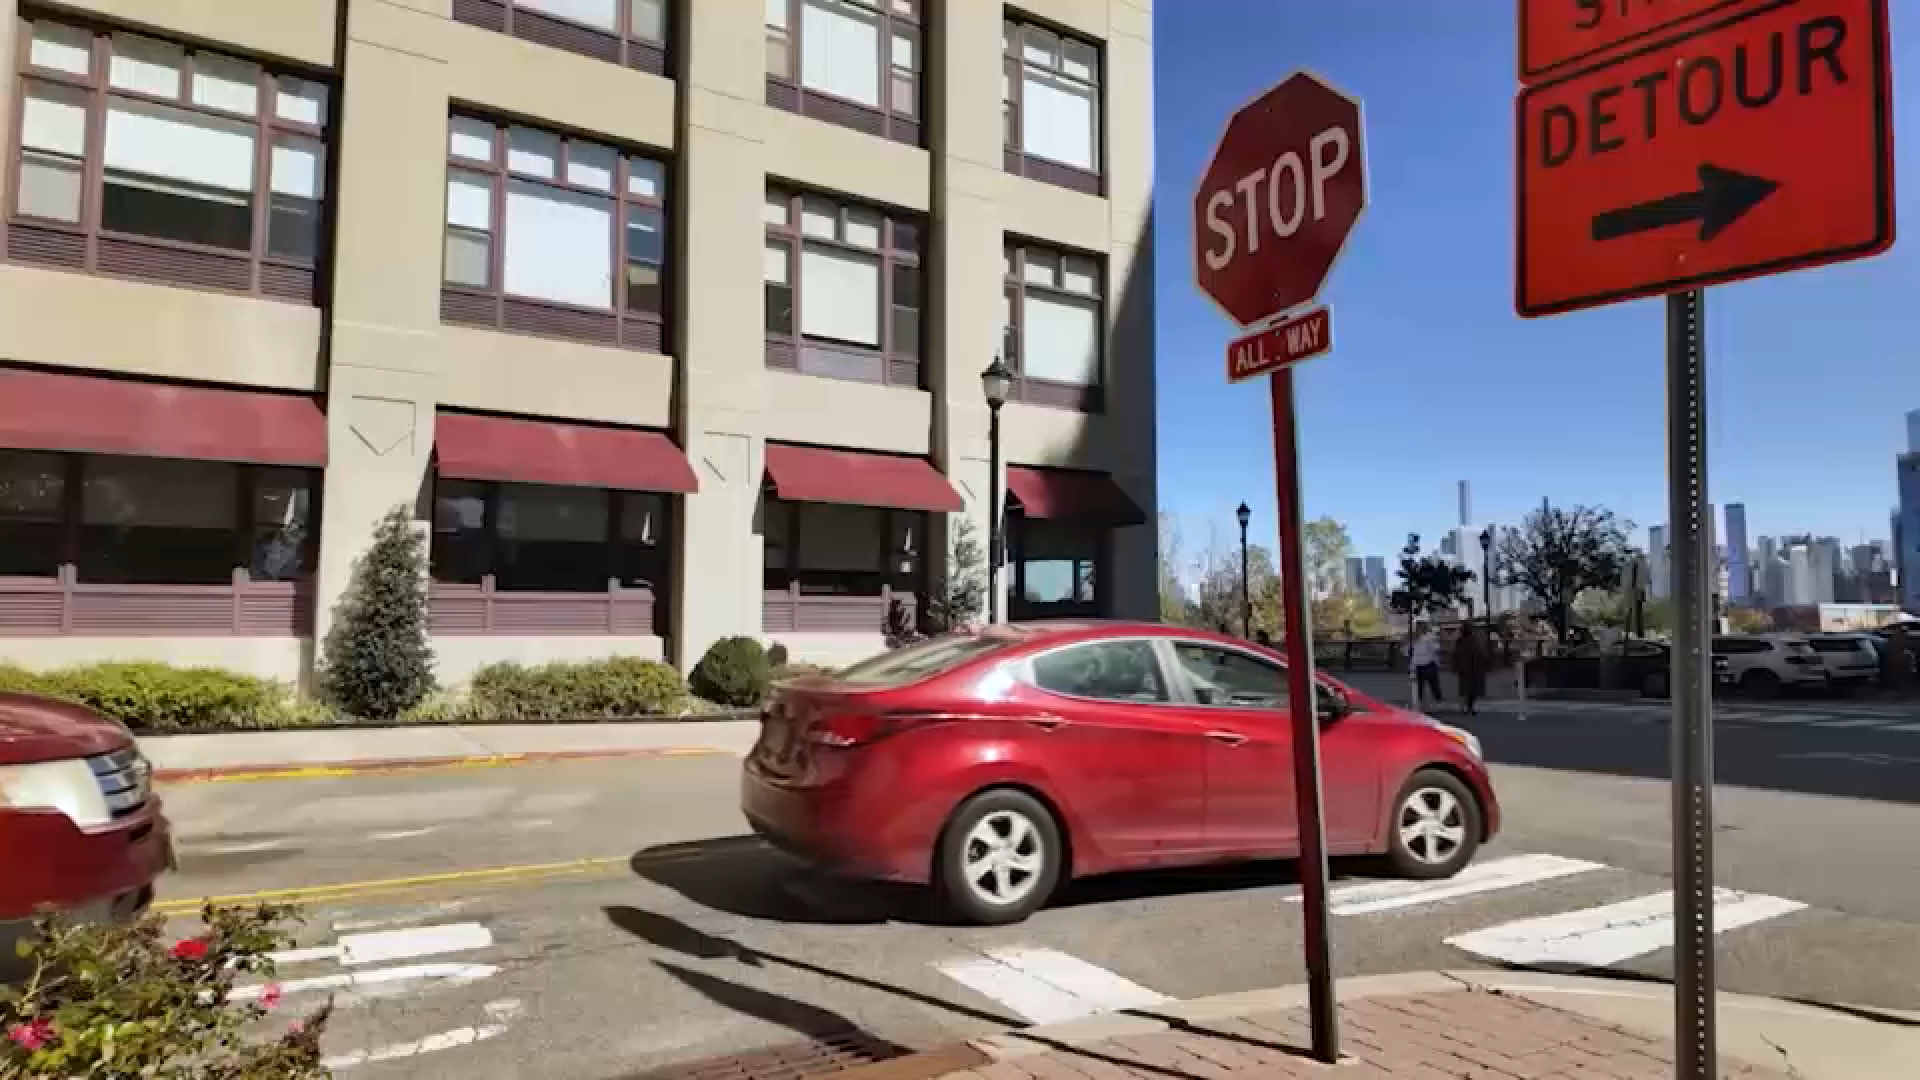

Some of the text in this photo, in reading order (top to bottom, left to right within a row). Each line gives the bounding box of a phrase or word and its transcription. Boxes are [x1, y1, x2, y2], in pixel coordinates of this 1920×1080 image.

[1541, 16, 1848, 168] DETOUR
[1205, 126, 1349, 270] STOP
[1235, 317, 1322, 373] ALL WAY
